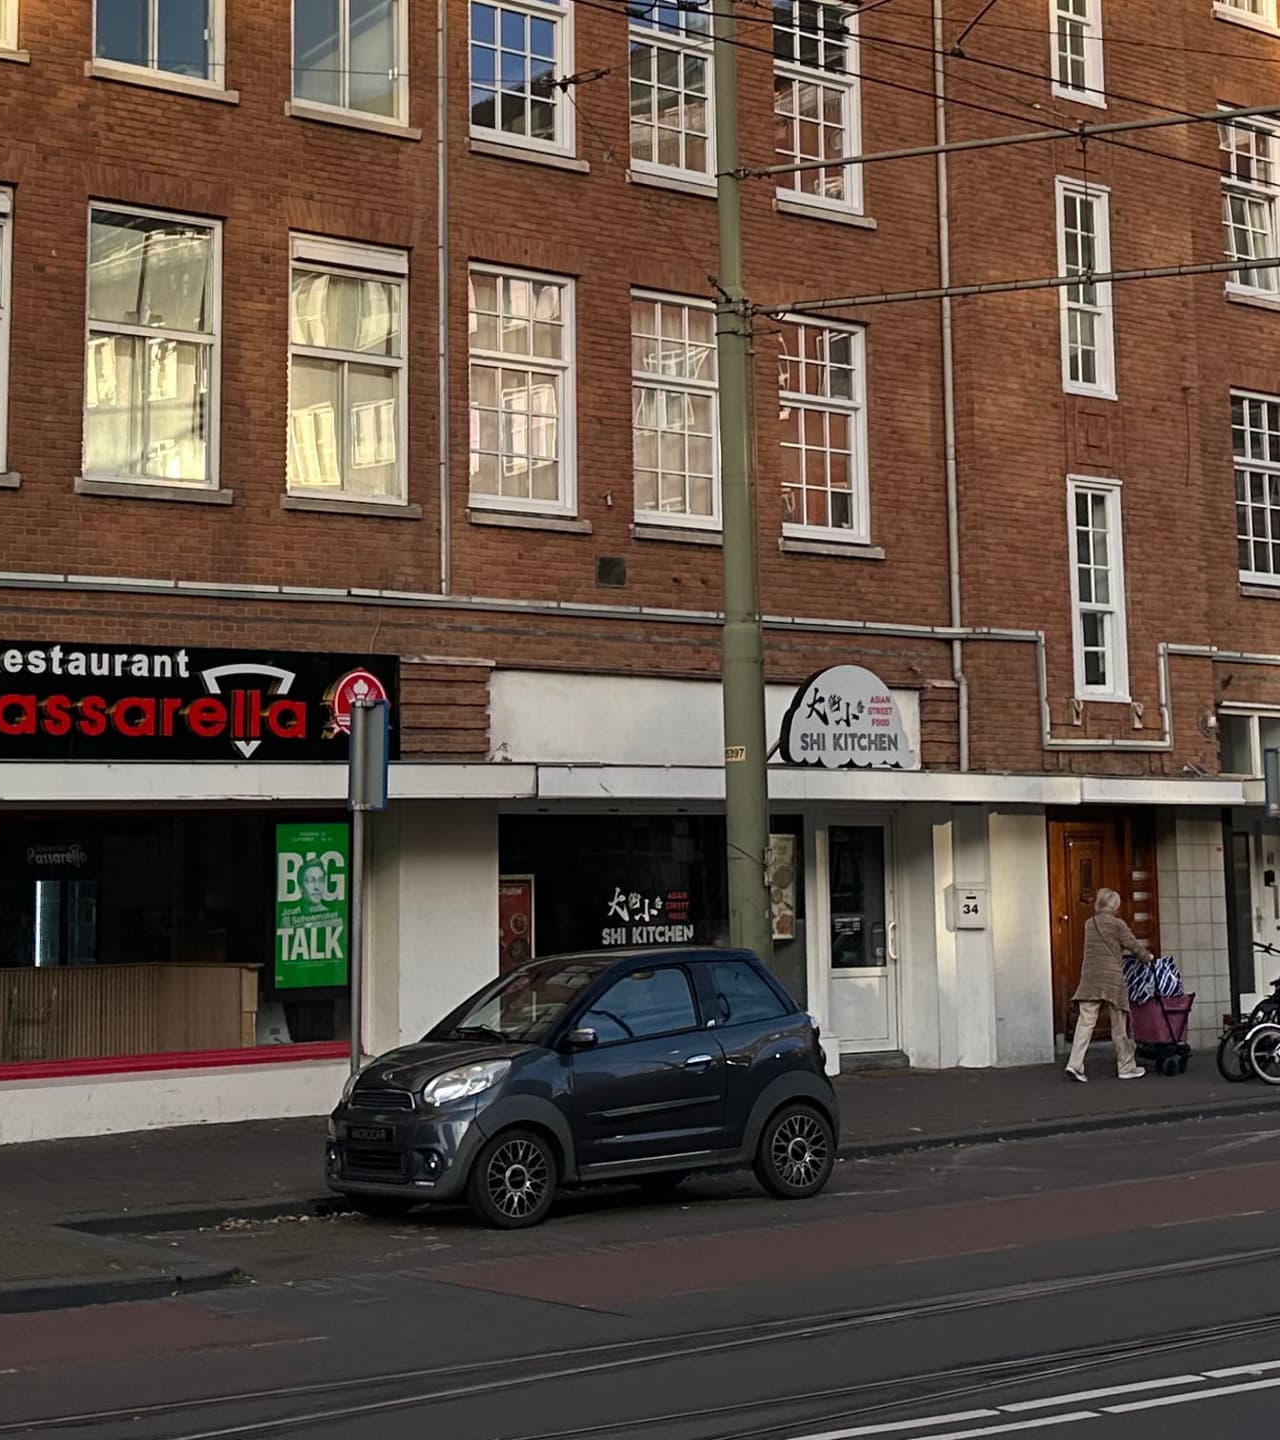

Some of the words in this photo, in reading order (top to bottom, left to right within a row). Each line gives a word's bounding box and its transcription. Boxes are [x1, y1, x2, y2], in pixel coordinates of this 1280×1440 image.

[870, 695, 891, 704] ASIAN
[868, 706, 893, 715] STREET
[871, 718, 890, 727] FOOD
[800, 732, 826, 751] SHI
[832, 733, 898, 751] KITCHEN
[277, 850, 345, 902] BG
[962, 904, 979, 915] 34
[602, 927, 626, 945] SHI
[632, 924, 694, 944] KITCHEN
[276, 926, 343, 961] TALK
